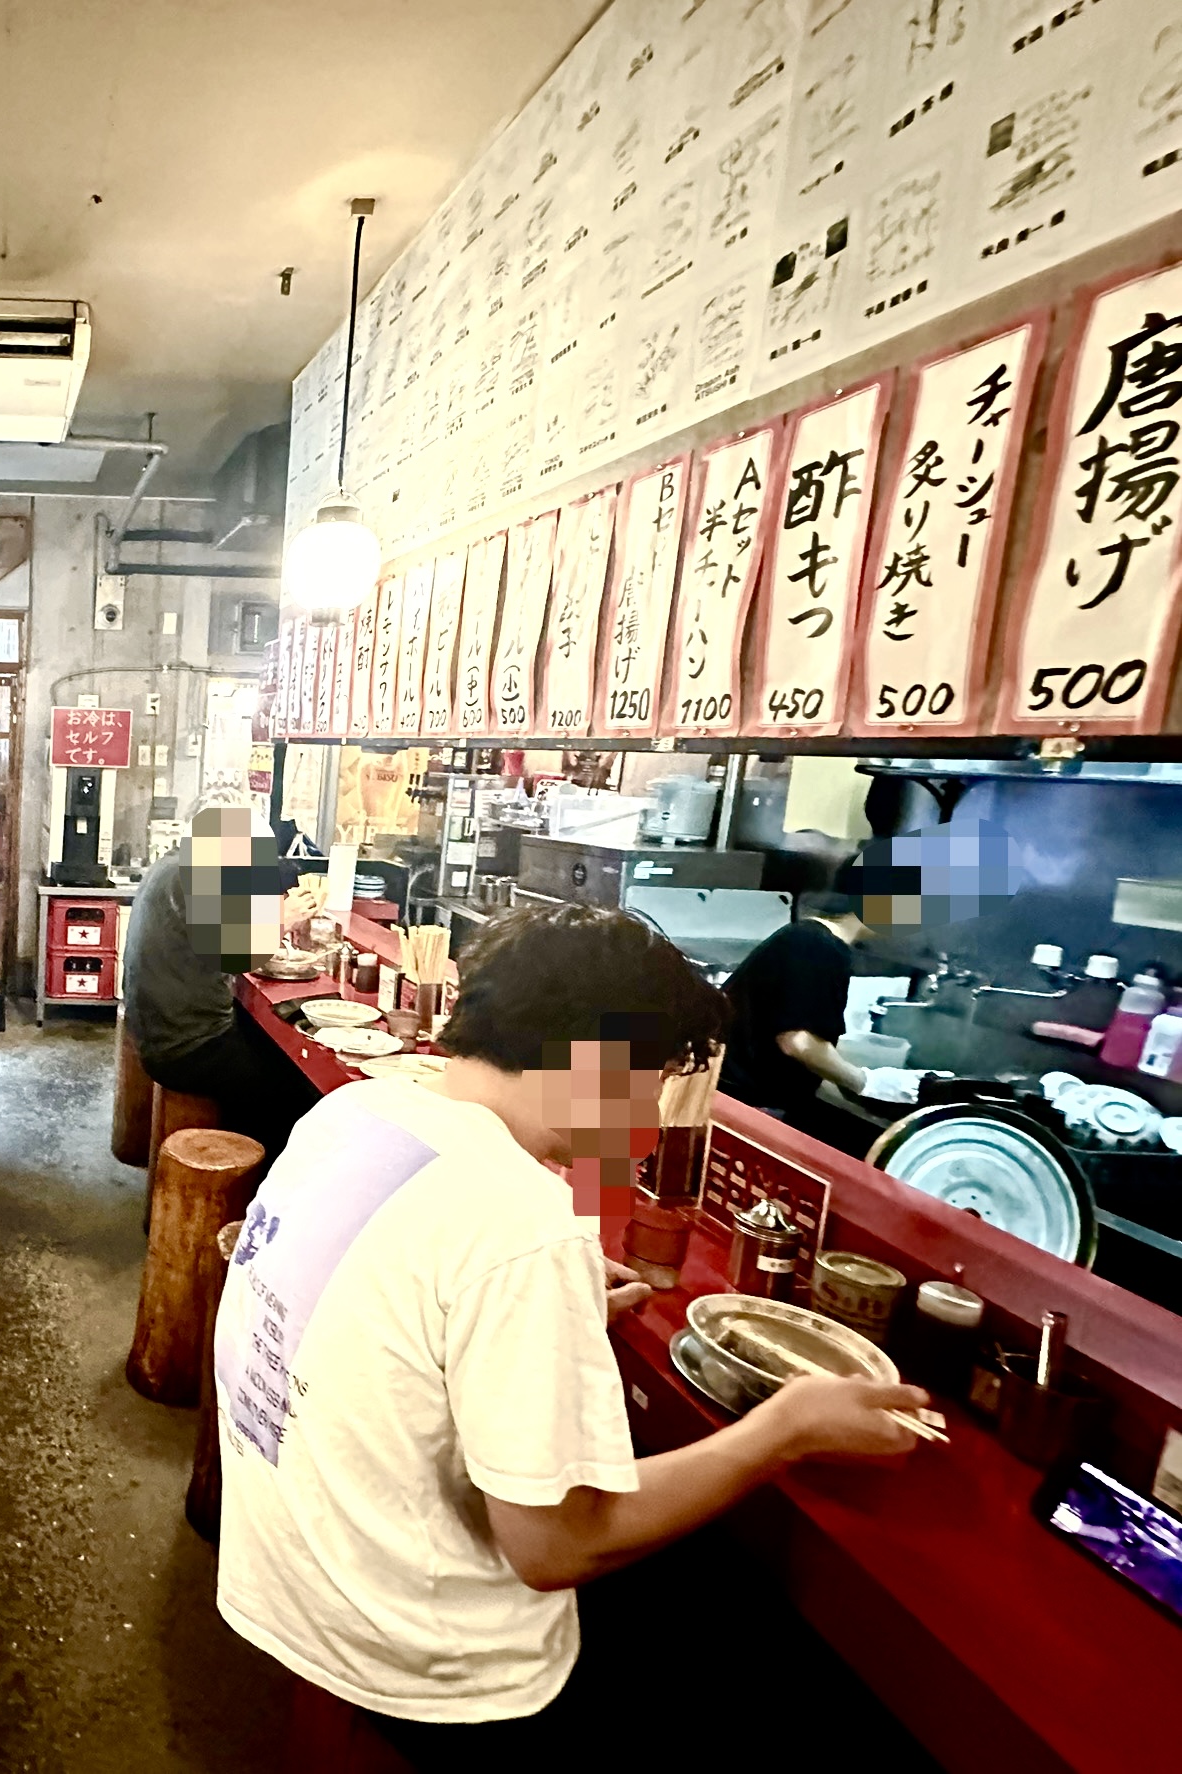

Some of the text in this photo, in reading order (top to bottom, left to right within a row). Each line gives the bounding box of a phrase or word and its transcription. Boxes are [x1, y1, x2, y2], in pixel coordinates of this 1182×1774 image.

[955, 363, 1012, 567] チャーシュー
[1066, 312, 1182, 610] 唐揚げ
[875, 440, 947, 641] 炙り焼き
[876, 682, 956, 719] 500
[1027, 659, 1148, 712] 500
[66, 710, 123, 728] お冷は、
[429, 709, 447, 729] 700
[462, 708, 483, 728] 600
[501, 705, 526, 726] 500
[551, 709, 582, 728] 1200
[610, 687, 650, 722] 1250
[681, 693, 732, 725] 1100
[768, 687, 824, 723] 450
[65, 730, 115, 746] セルフ
